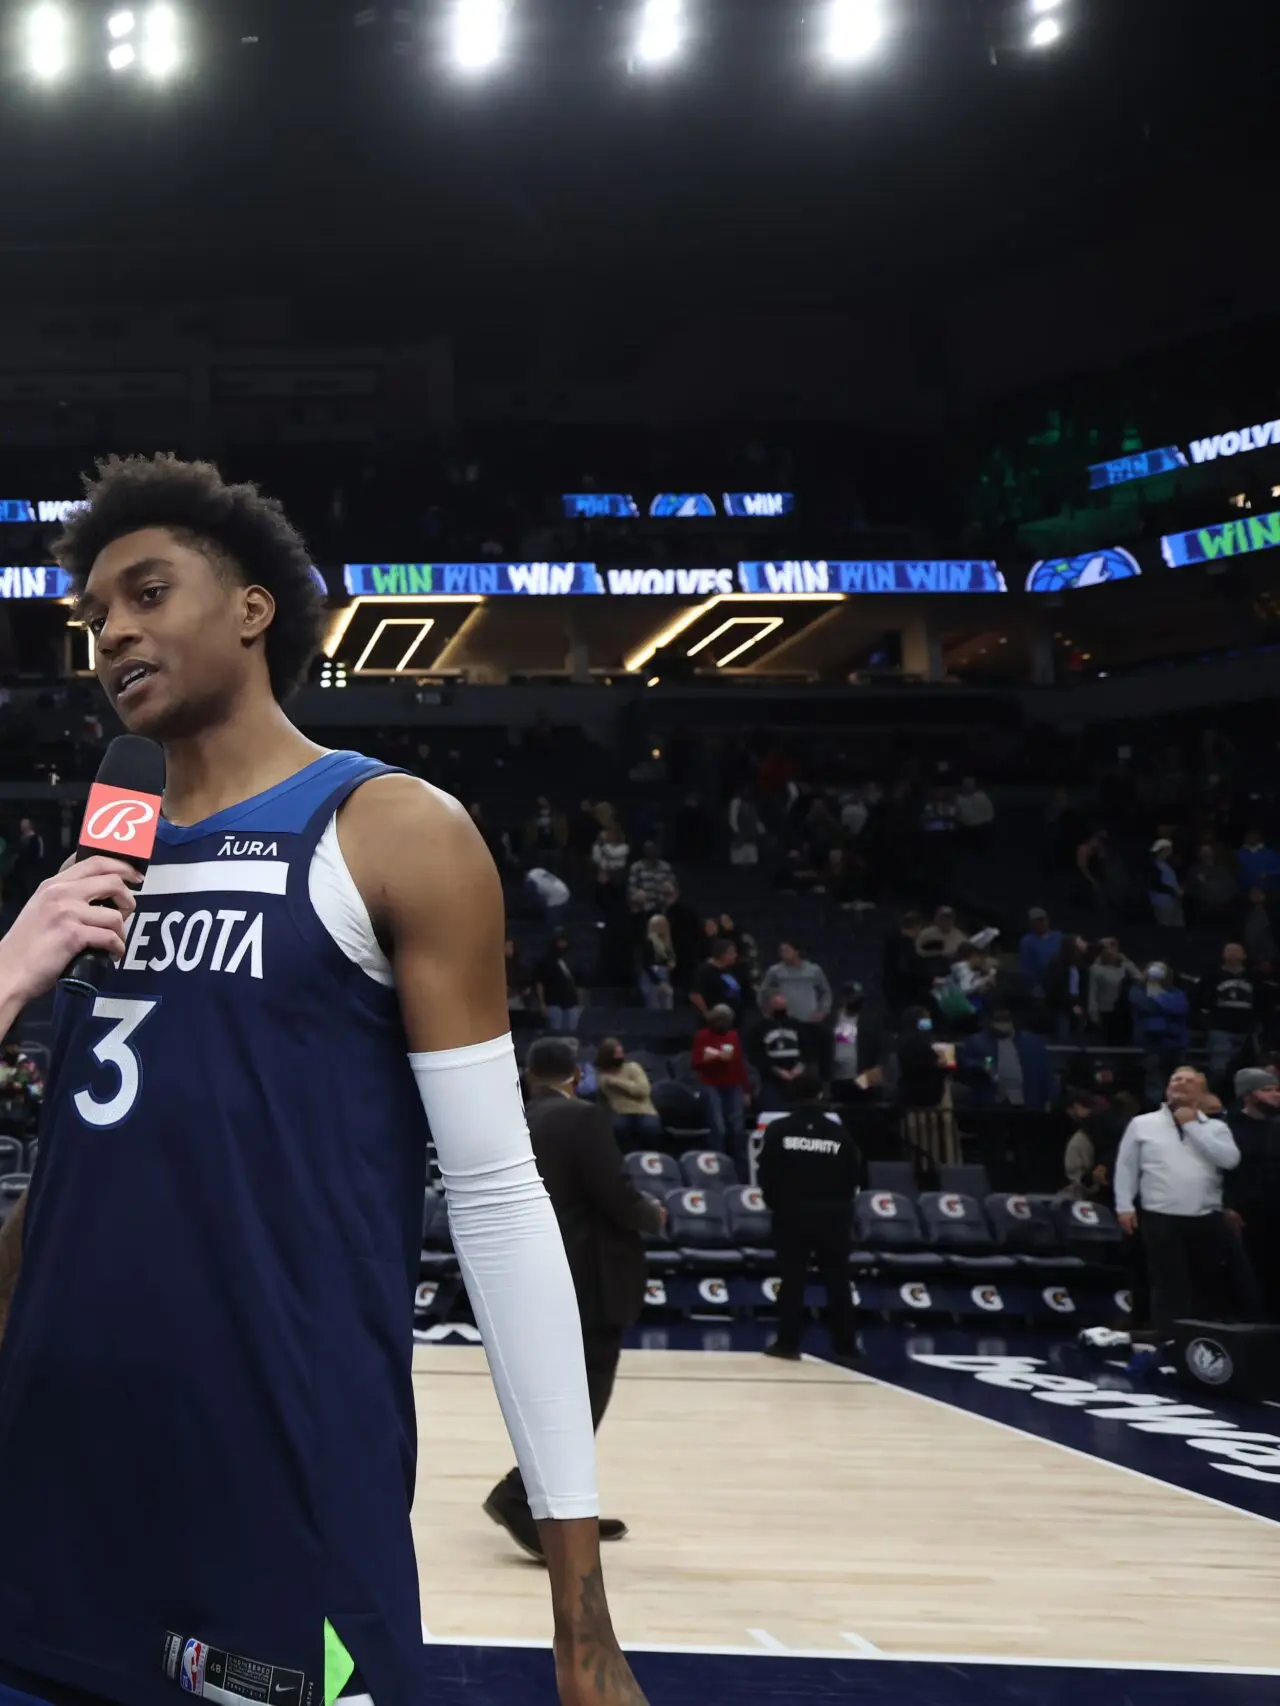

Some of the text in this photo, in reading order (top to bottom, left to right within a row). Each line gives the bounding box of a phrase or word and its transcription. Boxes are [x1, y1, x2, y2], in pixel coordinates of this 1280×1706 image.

[1198, 511, 1280, 559] WIN
[371, 562, 575, 595] WIN WIN WIN
[607, 568, 733, 595] WOLVES
[764, 560, 971, 593] WIN WIN WIN
[113, 908, 264, 980] ESOTA
[73, 995, 160, 1127] 3
[782, 1136, 842, 1155] SECURITY
